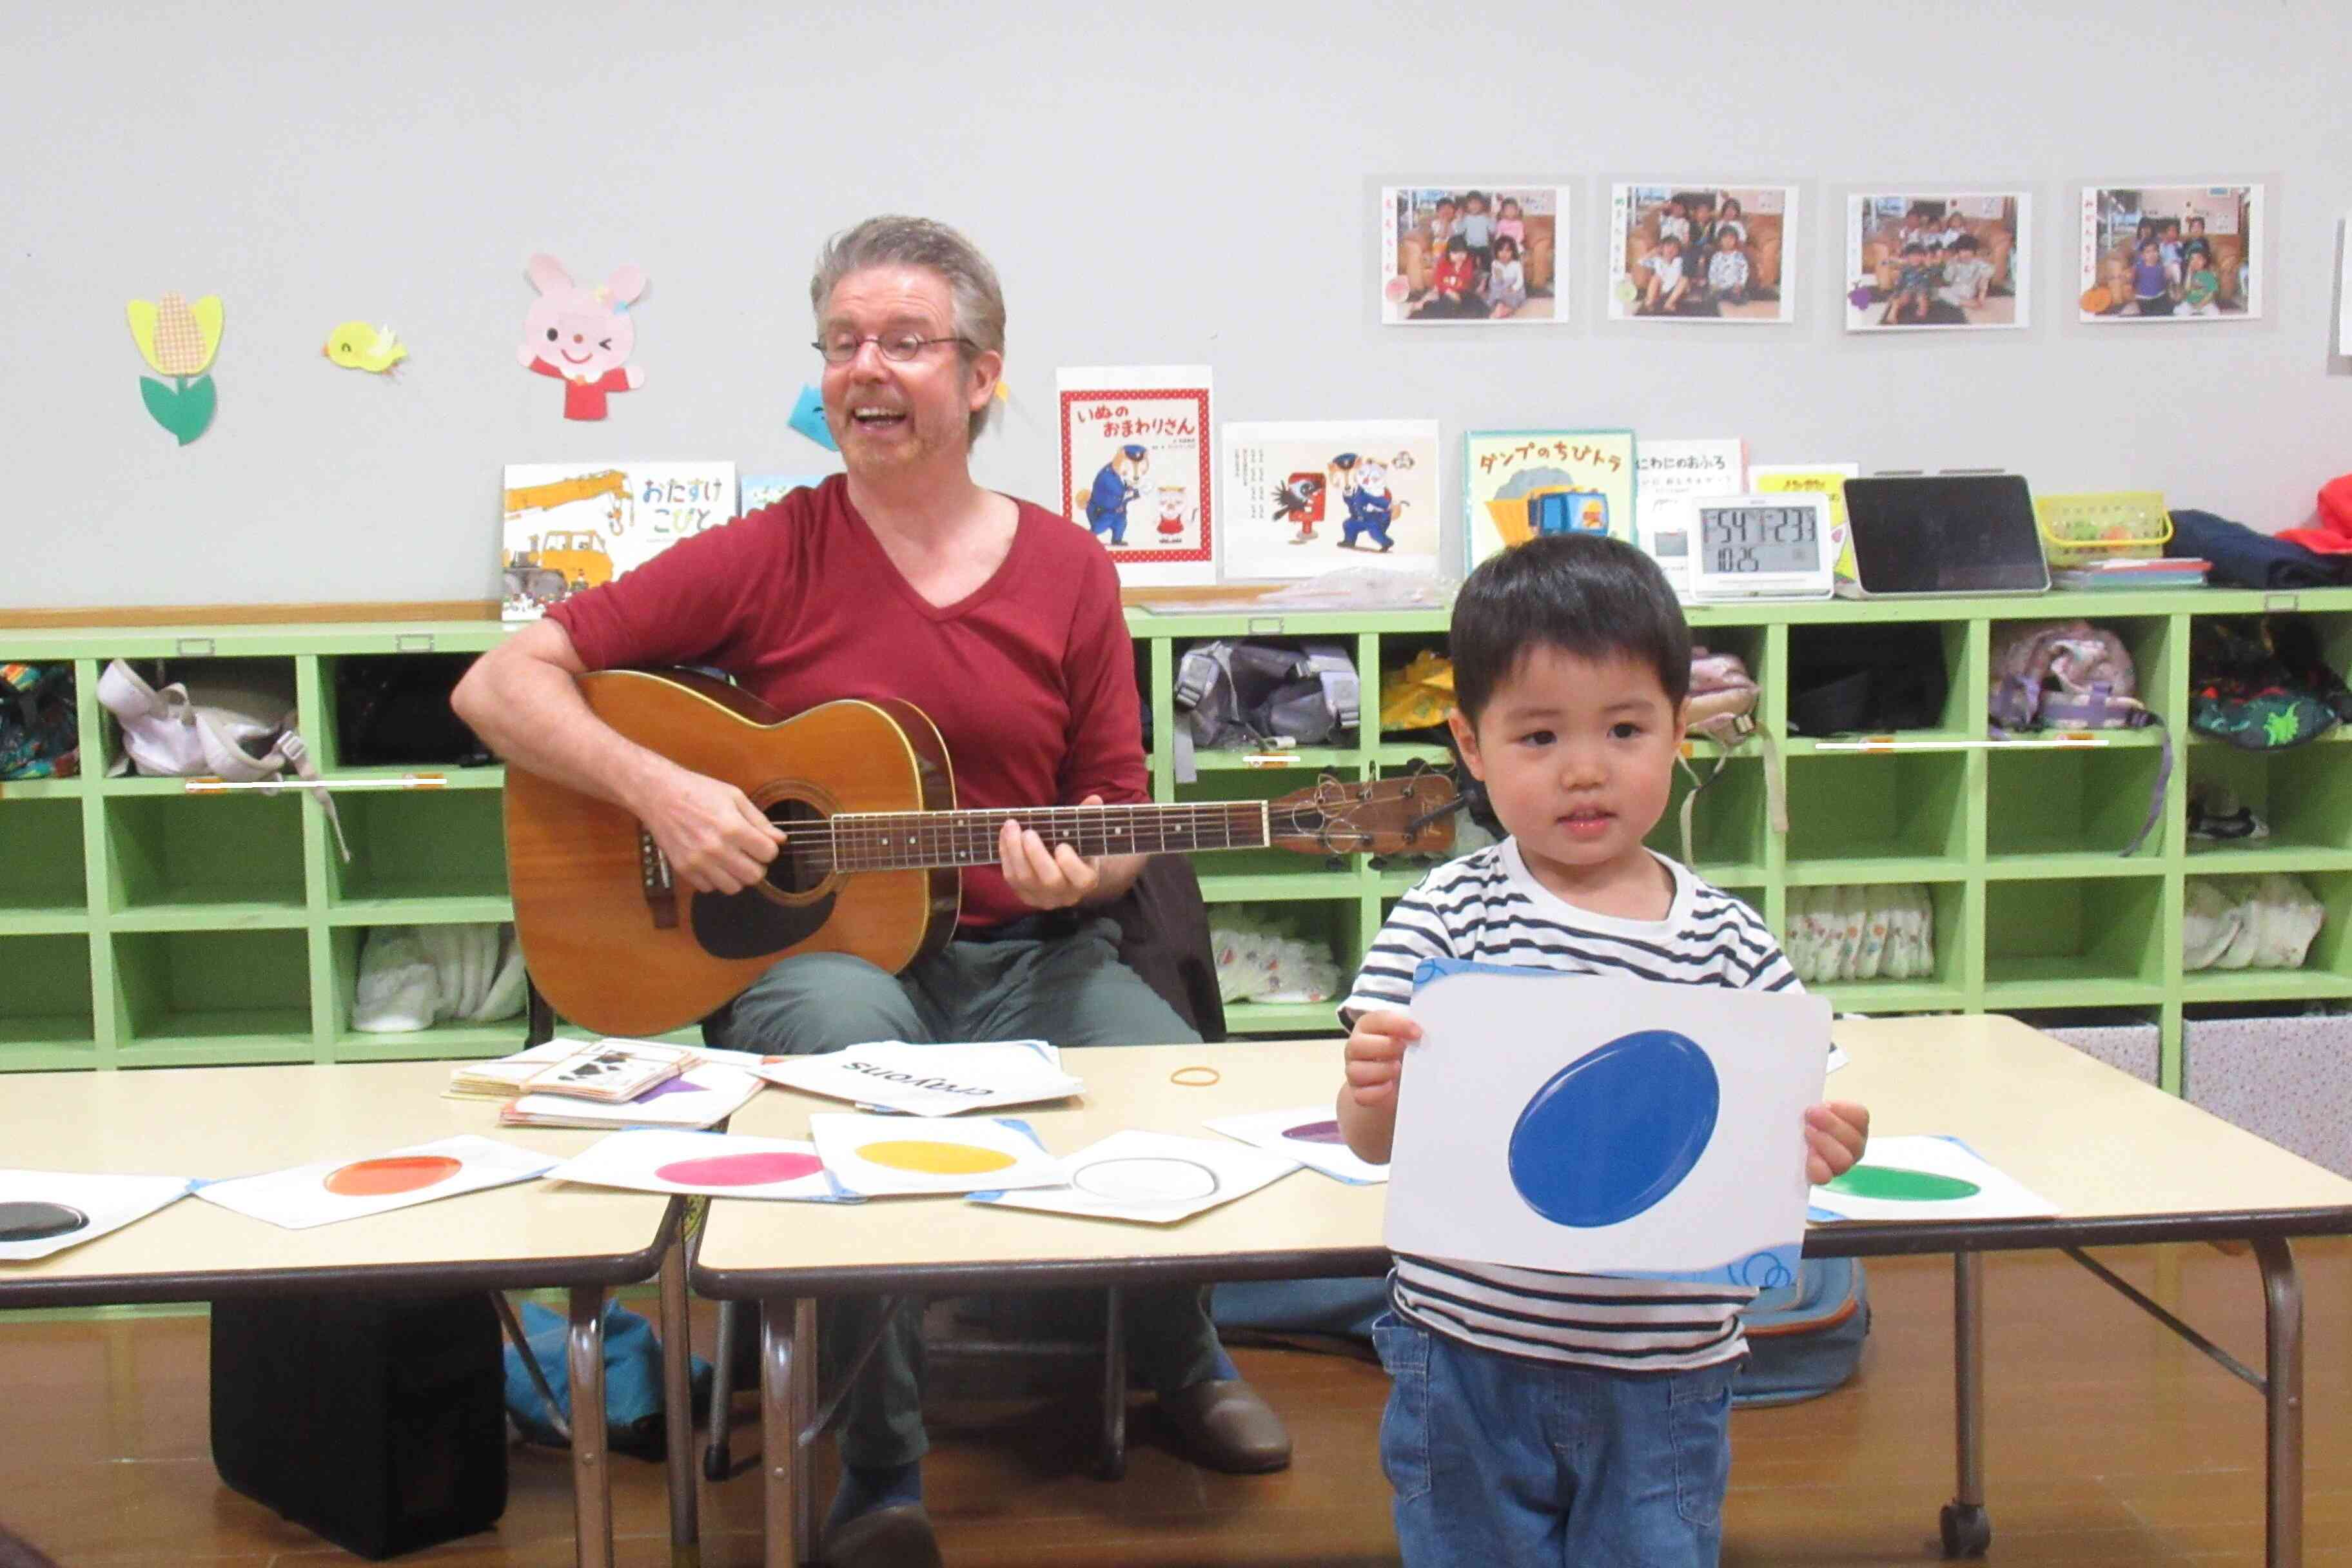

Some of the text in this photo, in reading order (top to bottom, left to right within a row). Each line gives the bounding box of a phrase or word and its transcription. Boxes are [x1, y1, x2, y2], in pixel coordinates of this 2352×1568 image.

[1077, 405, 1129, 423] いぬの
[1103, 418, 1195, 438] おまわりさん
[1480, 441, 1622, 475] ダンプのちびトラ
[643, 478, 723, 503] おたすけ
[653, 507, 711, 534] こびと
[841, 1061, 995, 1095] crayons
